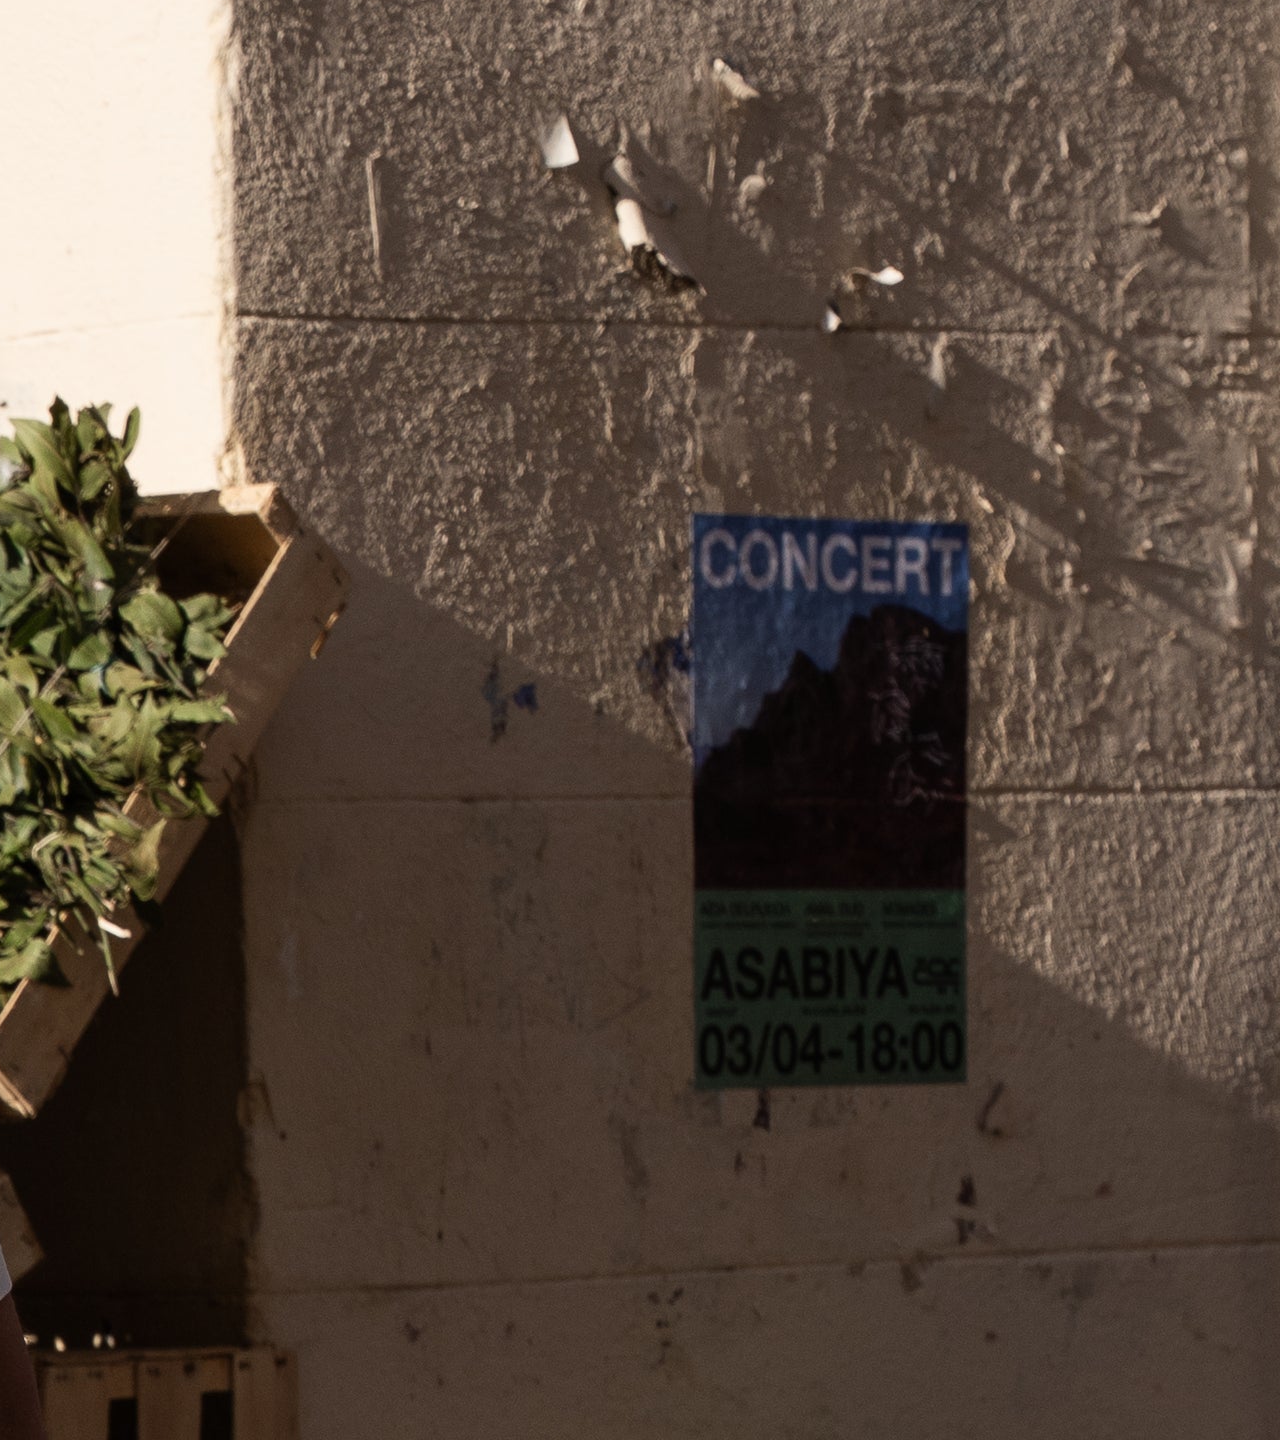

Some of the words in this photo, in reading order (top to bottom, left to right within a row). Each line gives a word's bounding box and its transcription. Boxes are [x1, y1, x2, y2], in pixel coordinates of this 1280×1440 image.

[697, 527, 965, 599] CONCERT
[700, 946, 910, 1003] ASABIYA
[698, 1020, 965, 1079] 03/04-18:00
